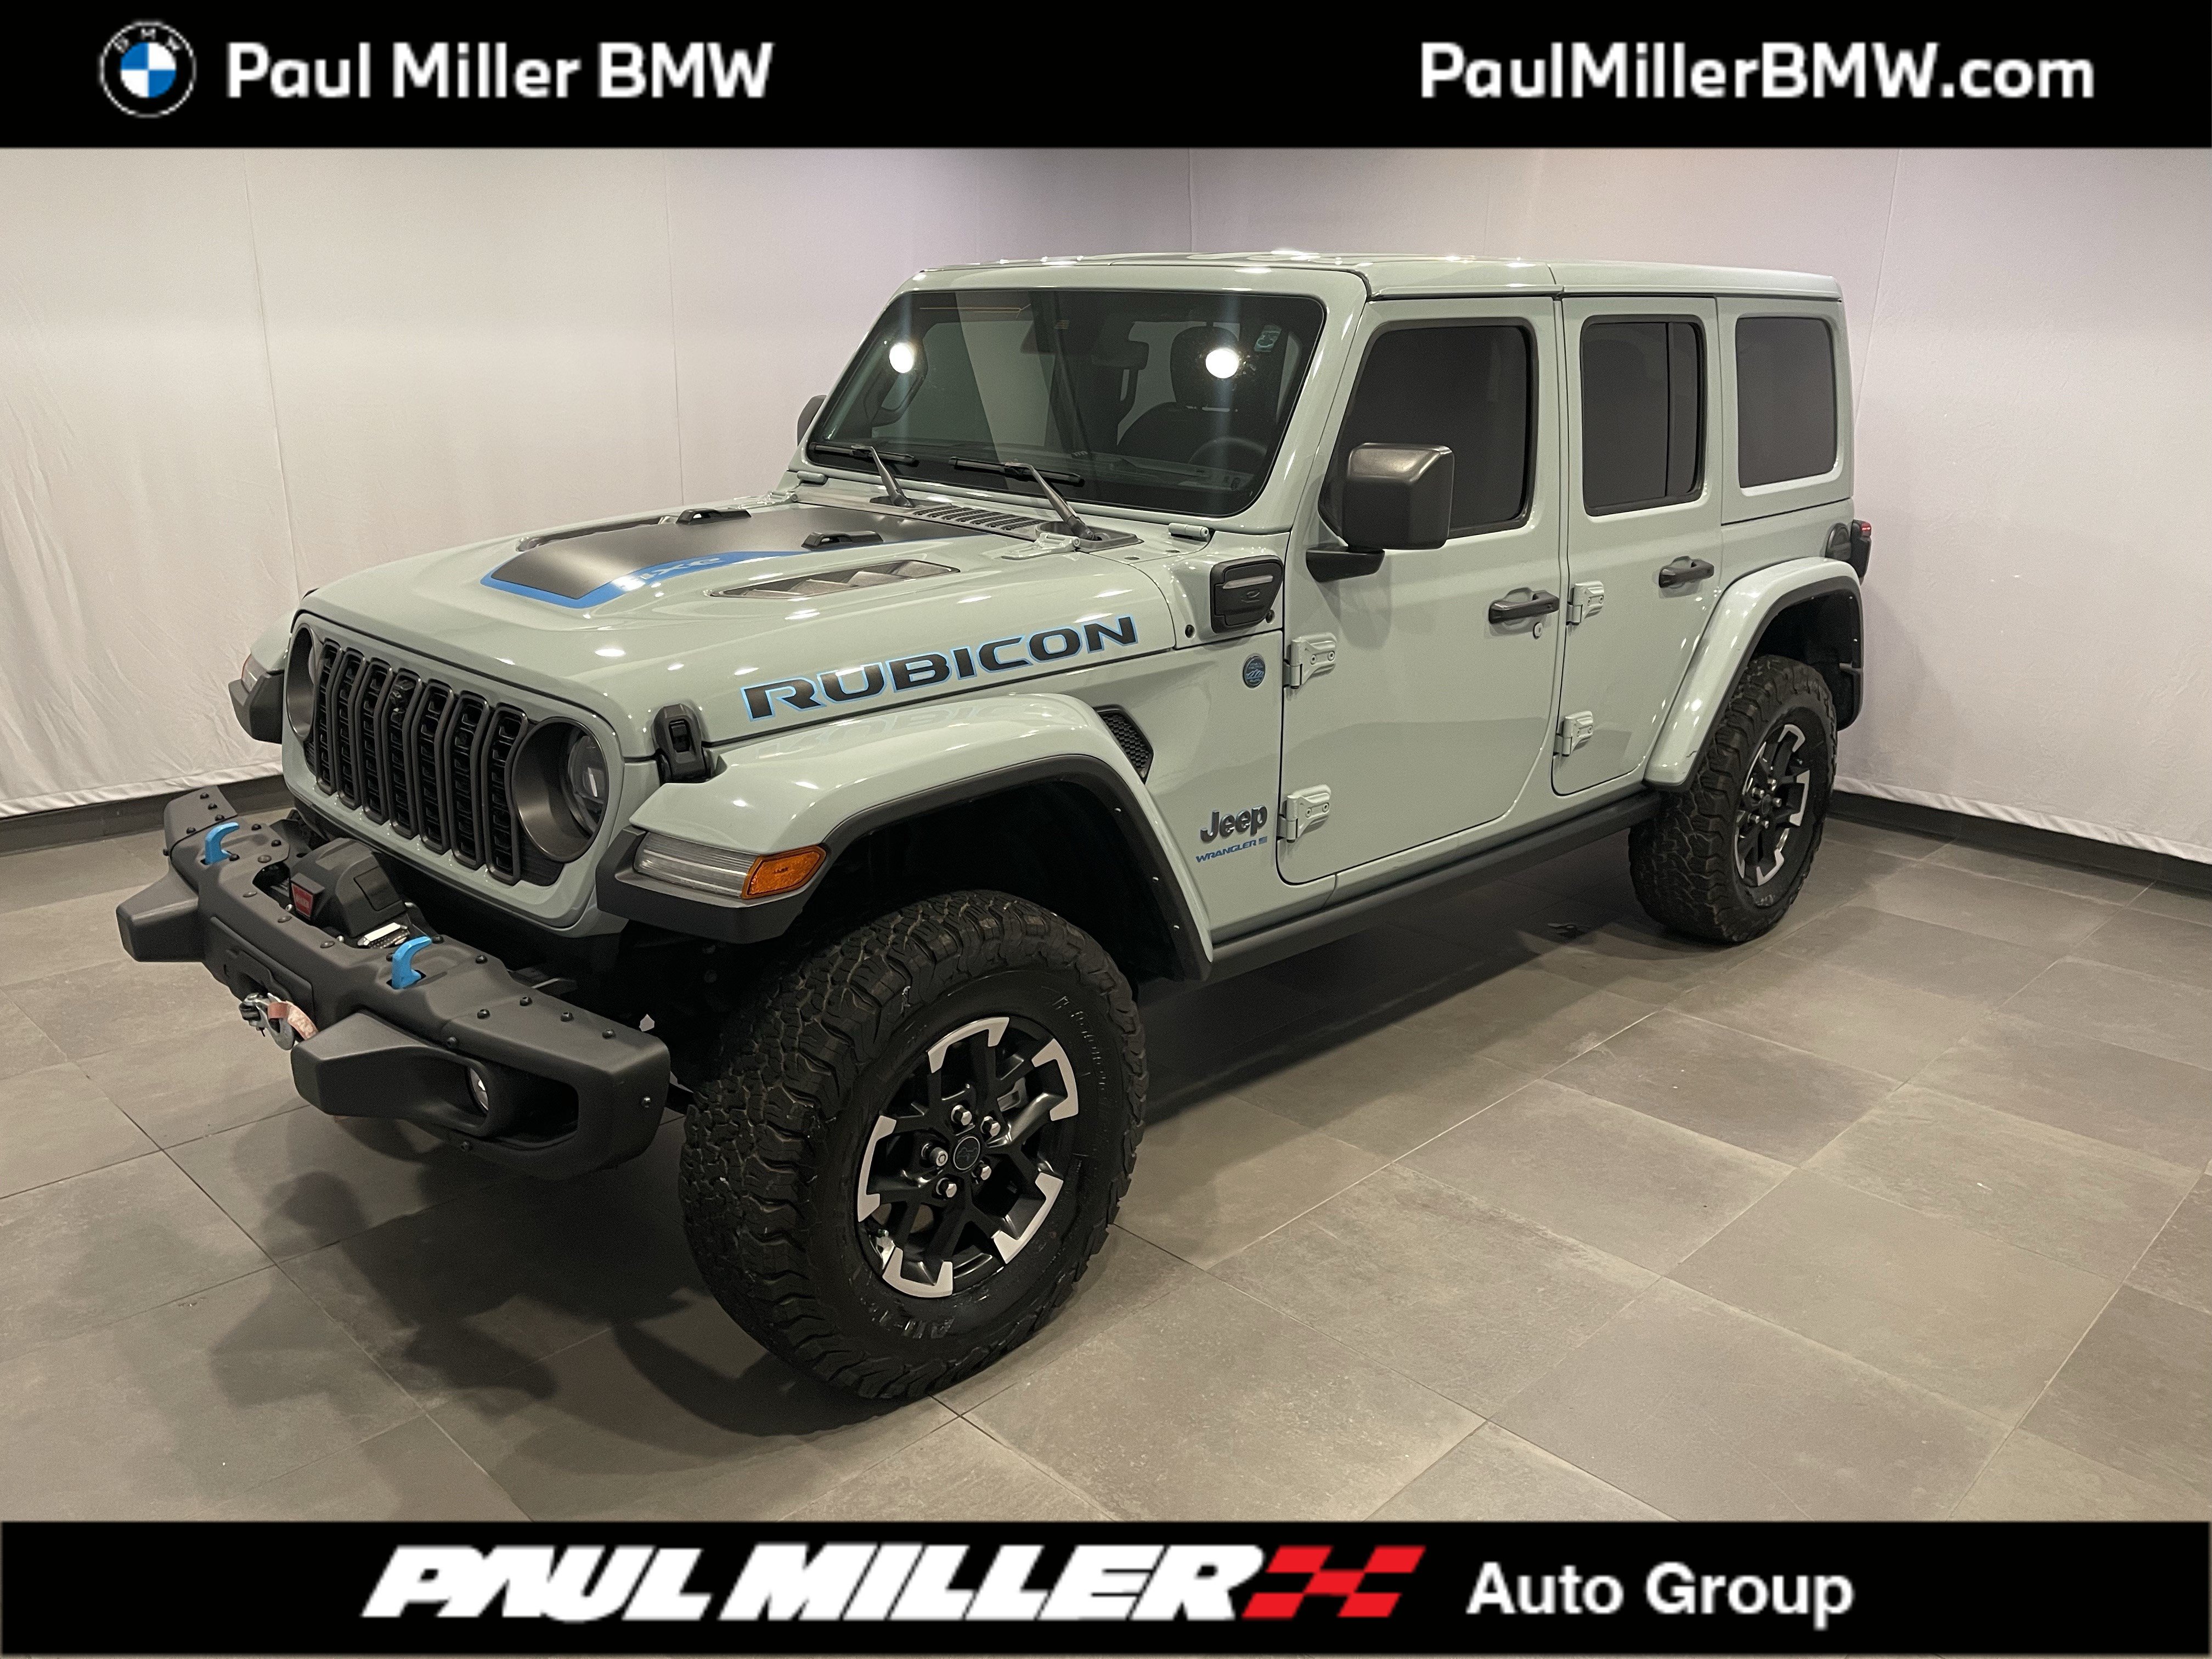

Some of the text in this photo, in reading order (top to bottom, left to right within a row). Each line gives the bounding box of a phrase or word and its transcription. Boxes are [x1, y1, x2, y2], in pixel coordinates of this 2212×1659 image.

[741, 616, 1139, 722] RUBICON
[1200, 804, 1268, 844] Jeep
[1195, 839, 1257, 863] WRANGLER
